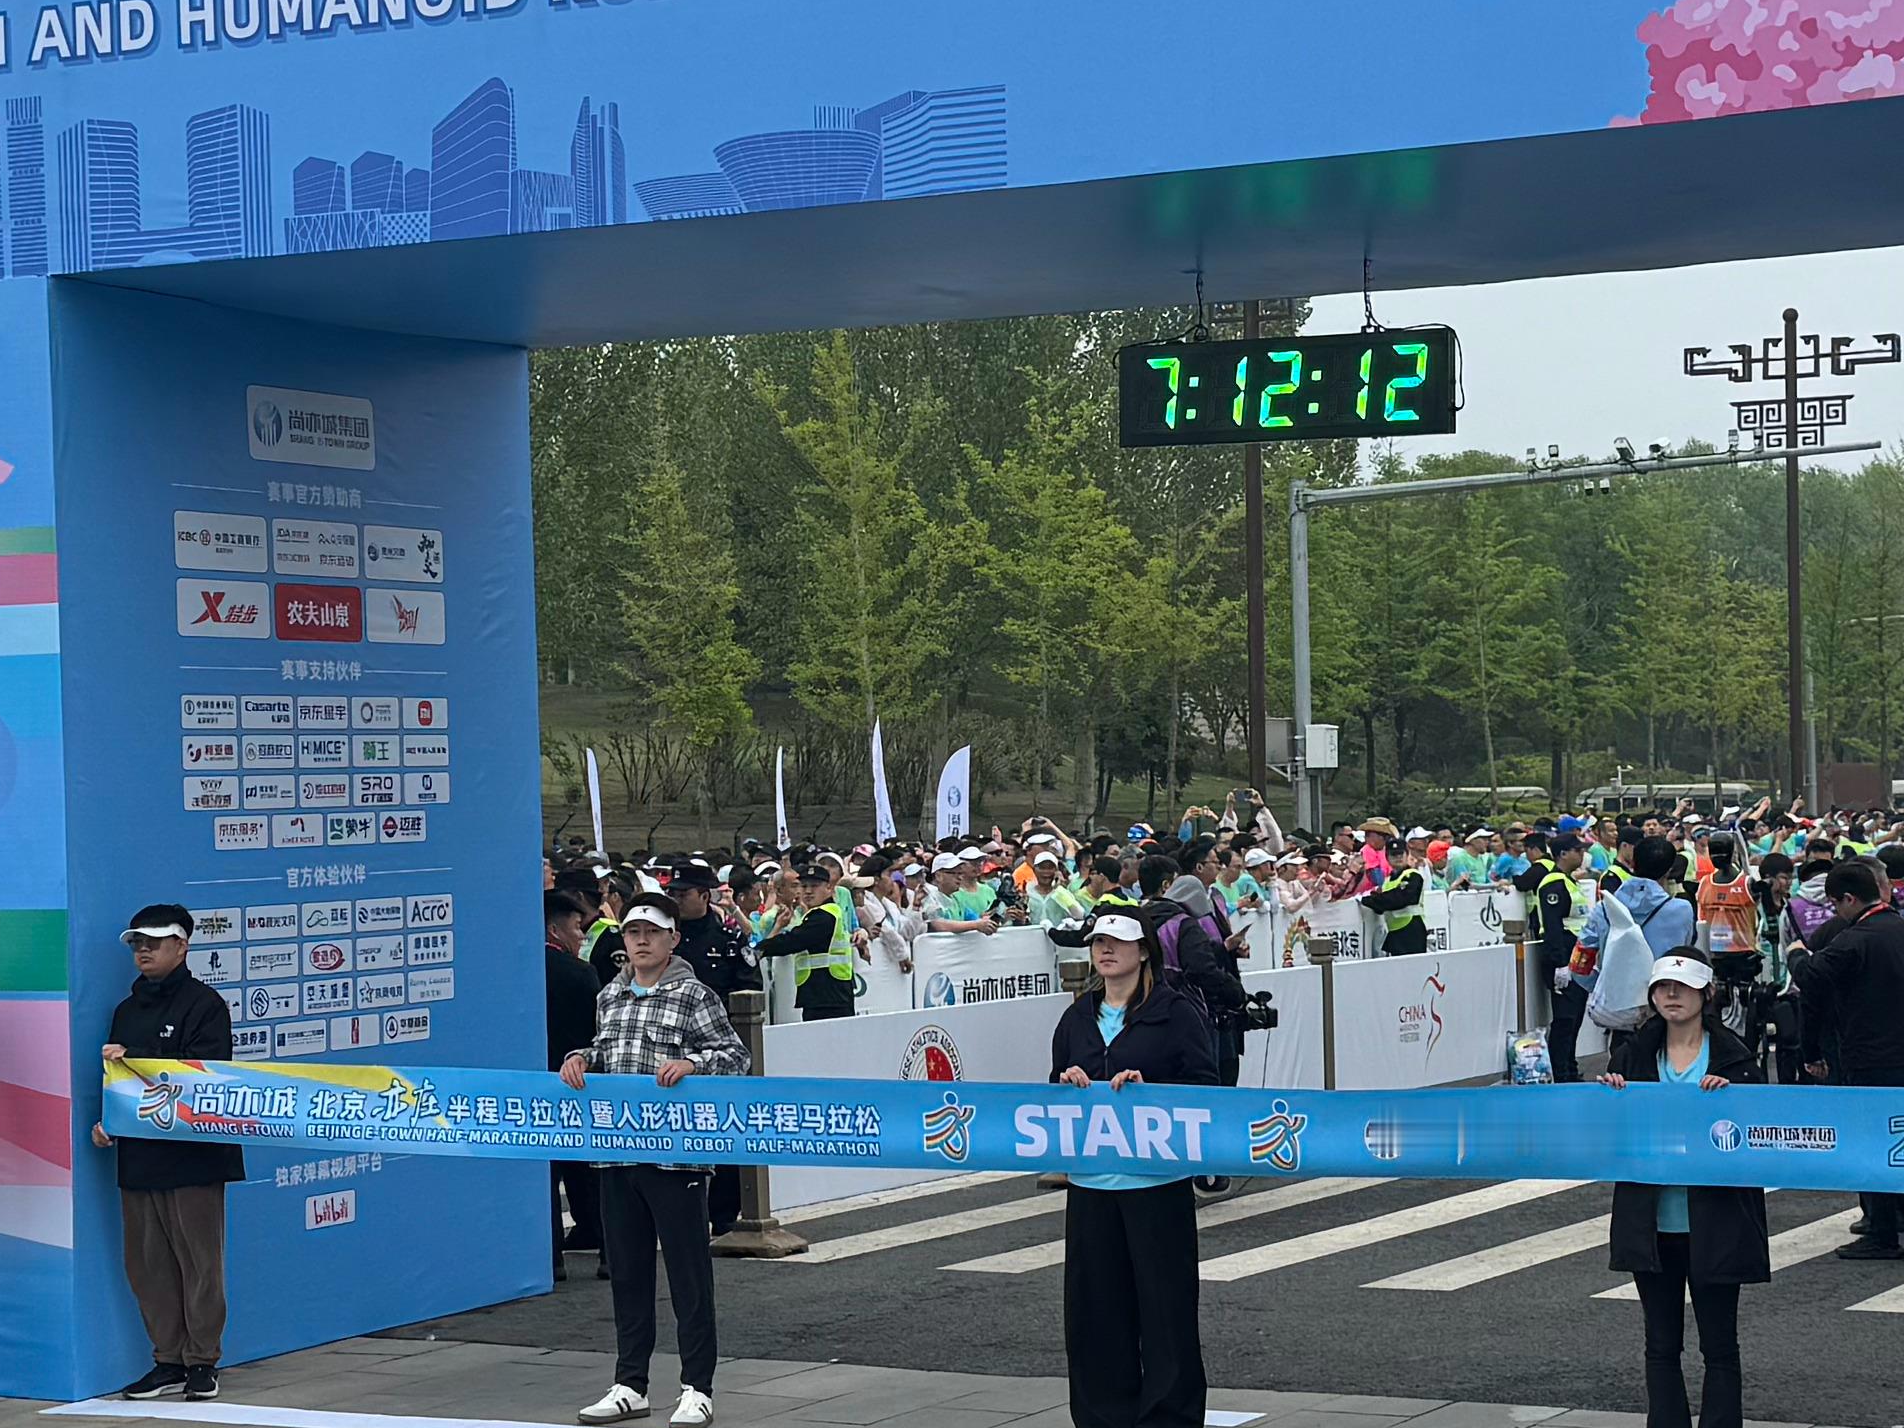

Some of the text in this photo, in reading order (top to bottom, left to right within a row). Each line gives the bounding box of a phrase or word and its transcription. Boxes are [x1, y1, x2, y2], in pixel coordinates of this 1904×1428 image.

[1146, 343, 1428, 430] 7:12:12
[288, 600, 349, 628] 农夫山泉
[193, 1083, 297, 1118] 尚亦城
[192, 1121, 881, 1158] SHANG E-TOWN BEIJING E-TOWN HALF-MARATHON AND HUMANOID ROBOT HALF-MARATHON
[1014, 1103, 1212, 1162] START
[275, 1152, 383, 1188] 独家弹幕视频平台
